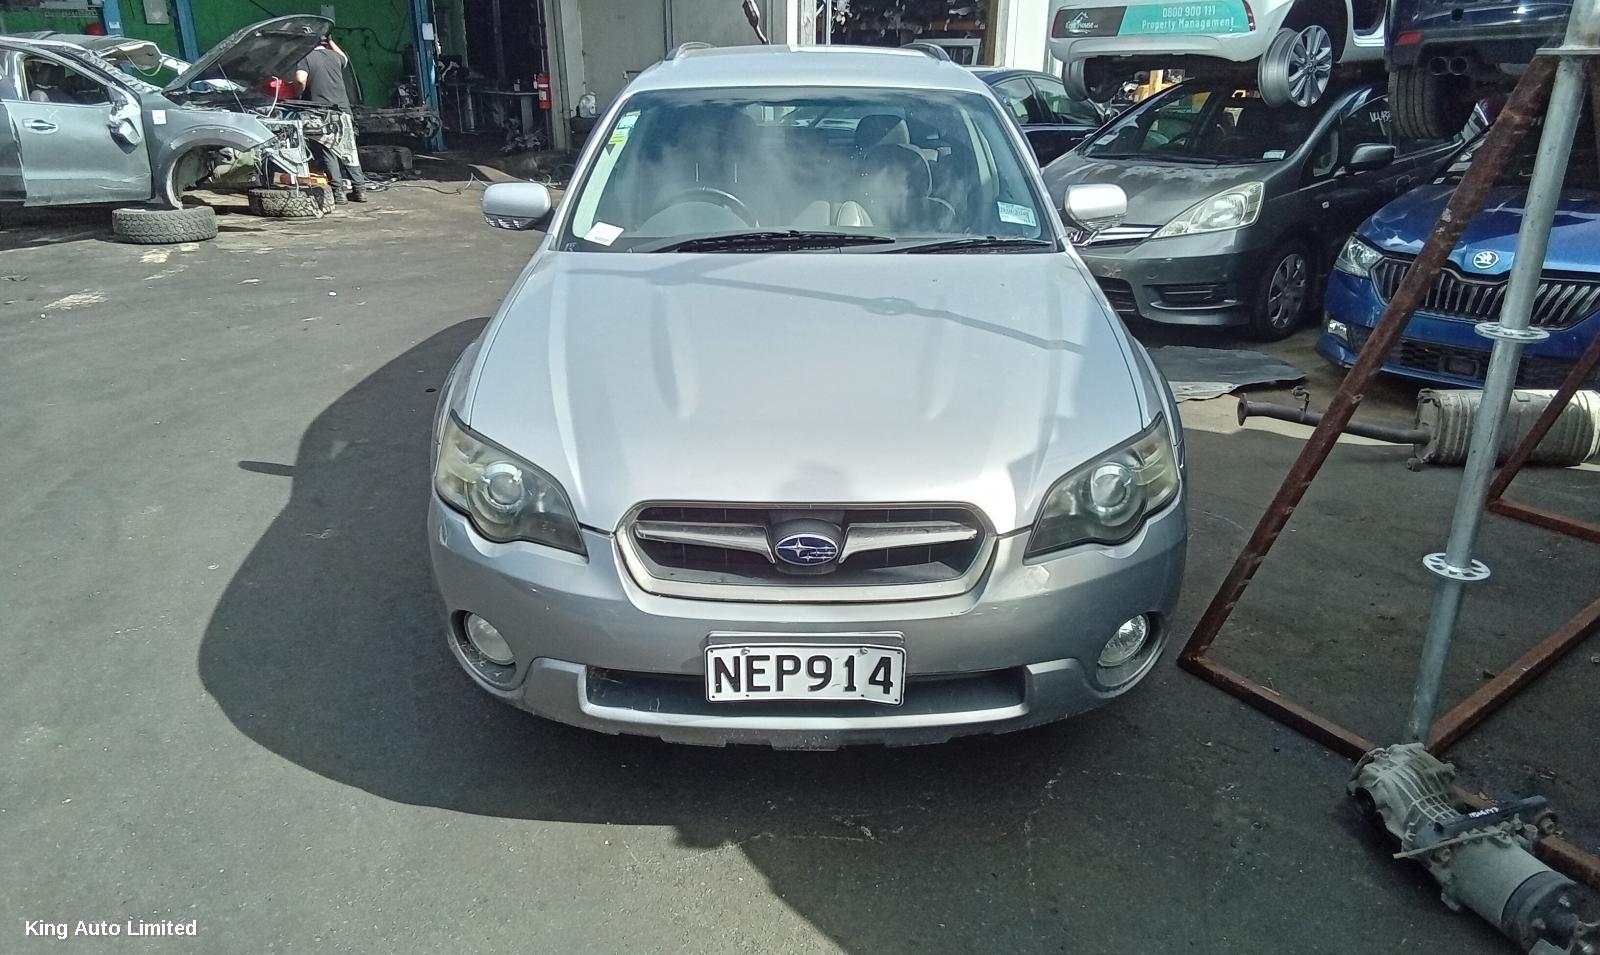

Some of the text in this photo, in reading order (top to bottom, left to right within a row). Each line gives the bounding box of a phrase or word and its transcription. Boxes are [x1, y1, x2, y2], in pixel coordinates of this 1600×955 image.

[1162, 5, 1216, 18] 0800 900 111
[1141, 17, 1234, 32] Property Management
[713, 655, 894, 695] NEP914
